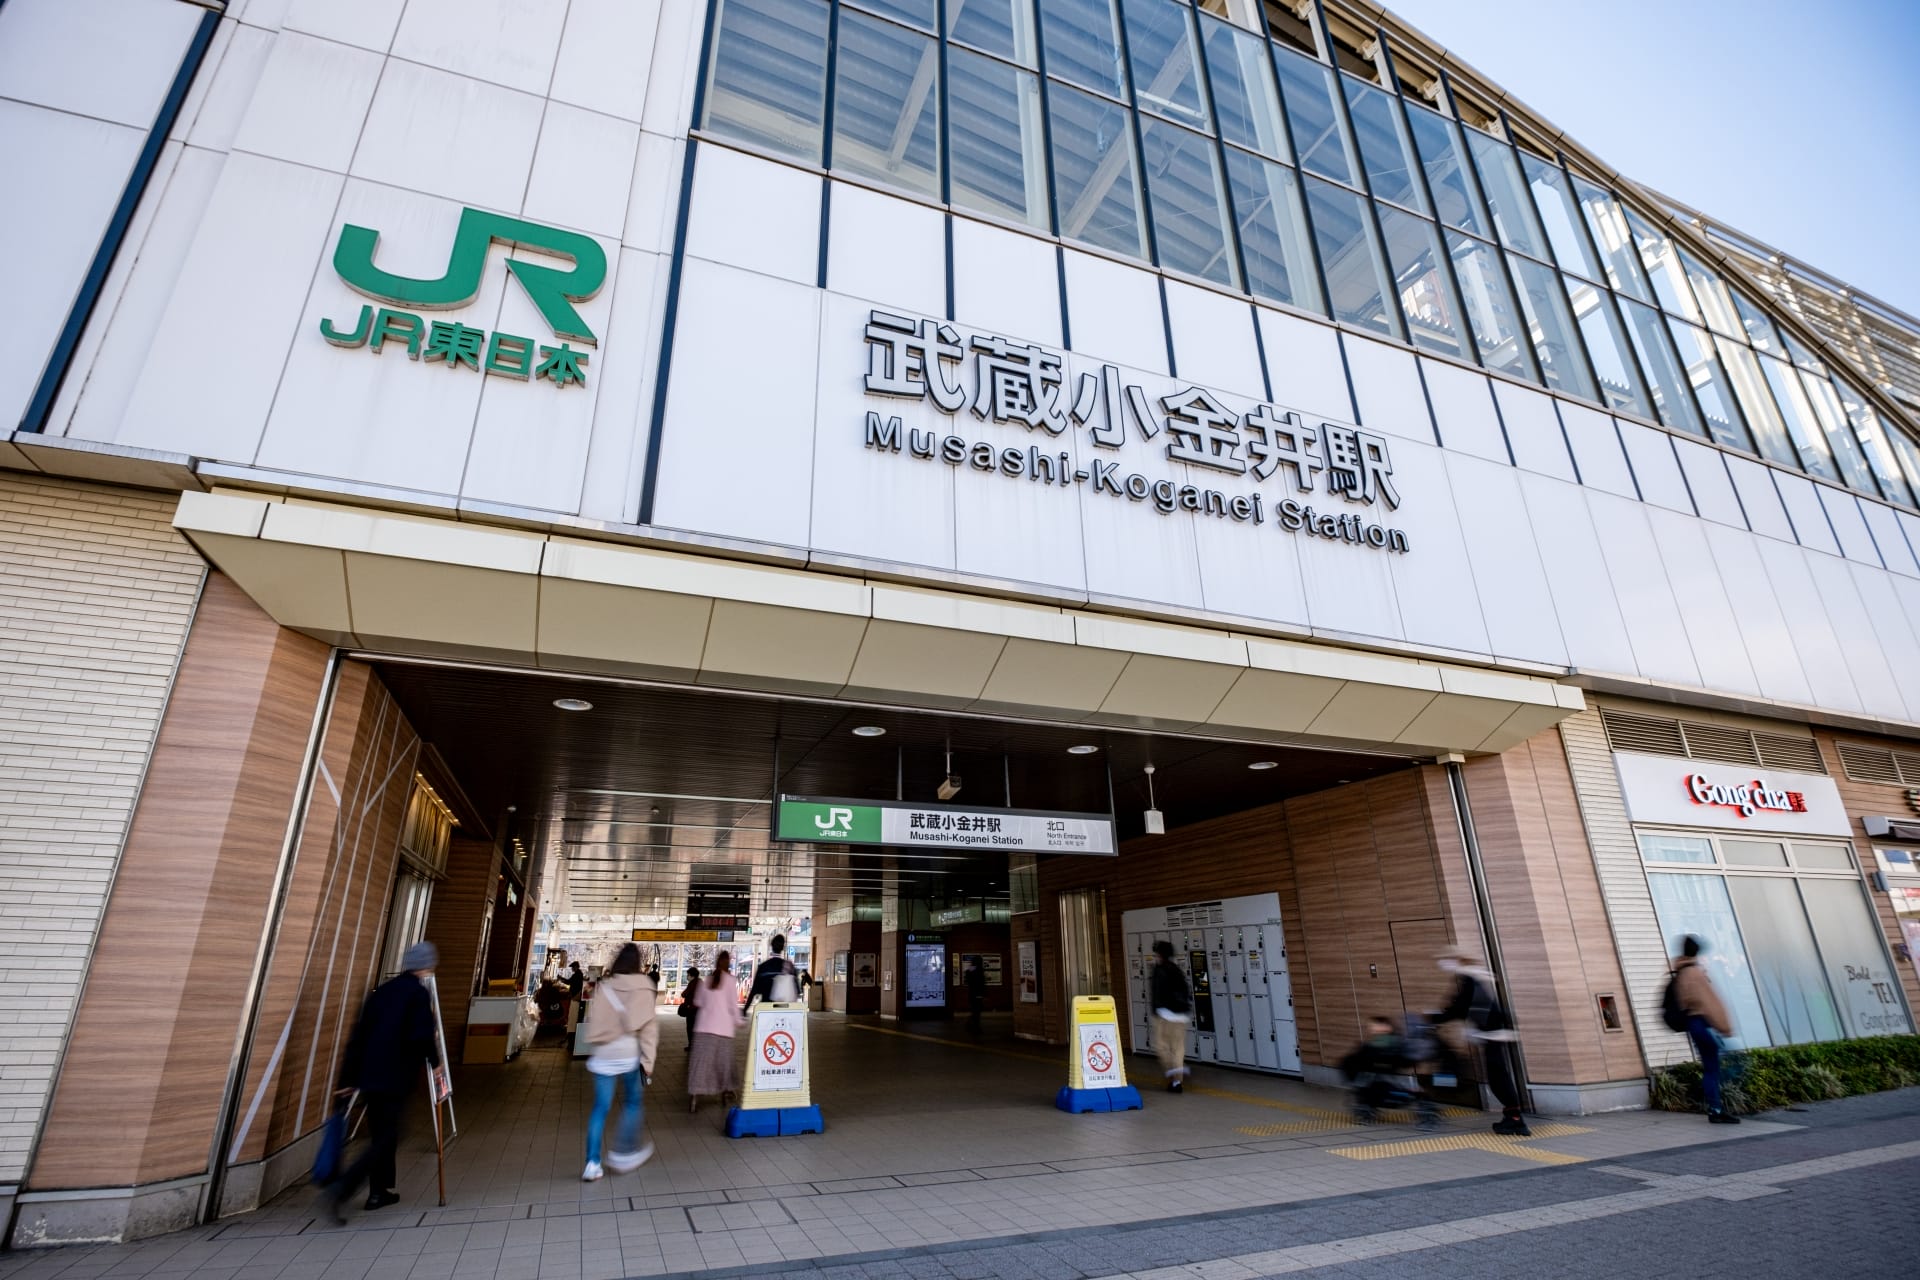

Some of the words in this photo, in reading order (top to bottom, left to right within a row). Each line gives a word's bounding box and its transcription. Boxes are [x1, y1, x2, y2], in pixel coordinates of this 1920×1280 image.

[333, 207, 607, 350] JR
[320, 305, 589, 389] JR東日本
[864, 309, 1401, 511] 武蔵小金井駅
[865, 410, 1265, 526] Musashi-Koganei
[1277, 499, 1410, 554] Station
[1688, 773, 1756, 818] Gong
[1753, 779, 1793, 811] cha
[815, 807, 853, 830] JR
[910, 813, 1002, 832] 武蔵小金井駅
[910, 831, 990, 845] Musashi-Koganei
[992, 835, 1024, 845] Station
[1046, 821, 1065, 831] 北口
